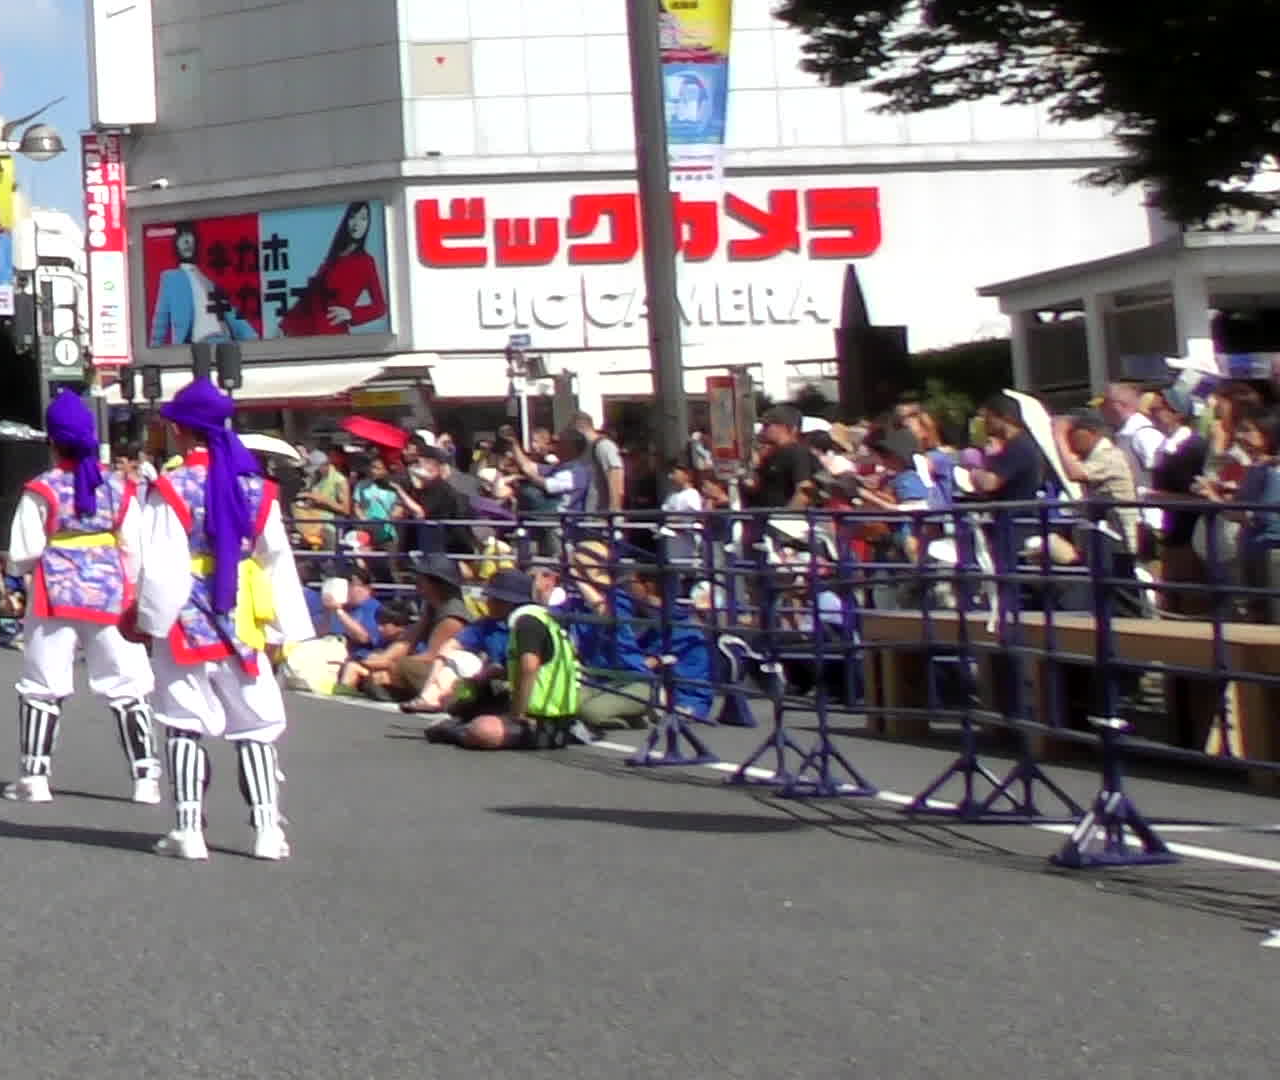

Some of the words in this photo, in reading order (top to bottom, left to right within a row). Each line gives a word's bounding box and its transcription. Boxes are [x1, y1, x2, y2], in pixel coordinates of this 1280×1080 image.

[414, 186, 882, 268] ビックカメラ
